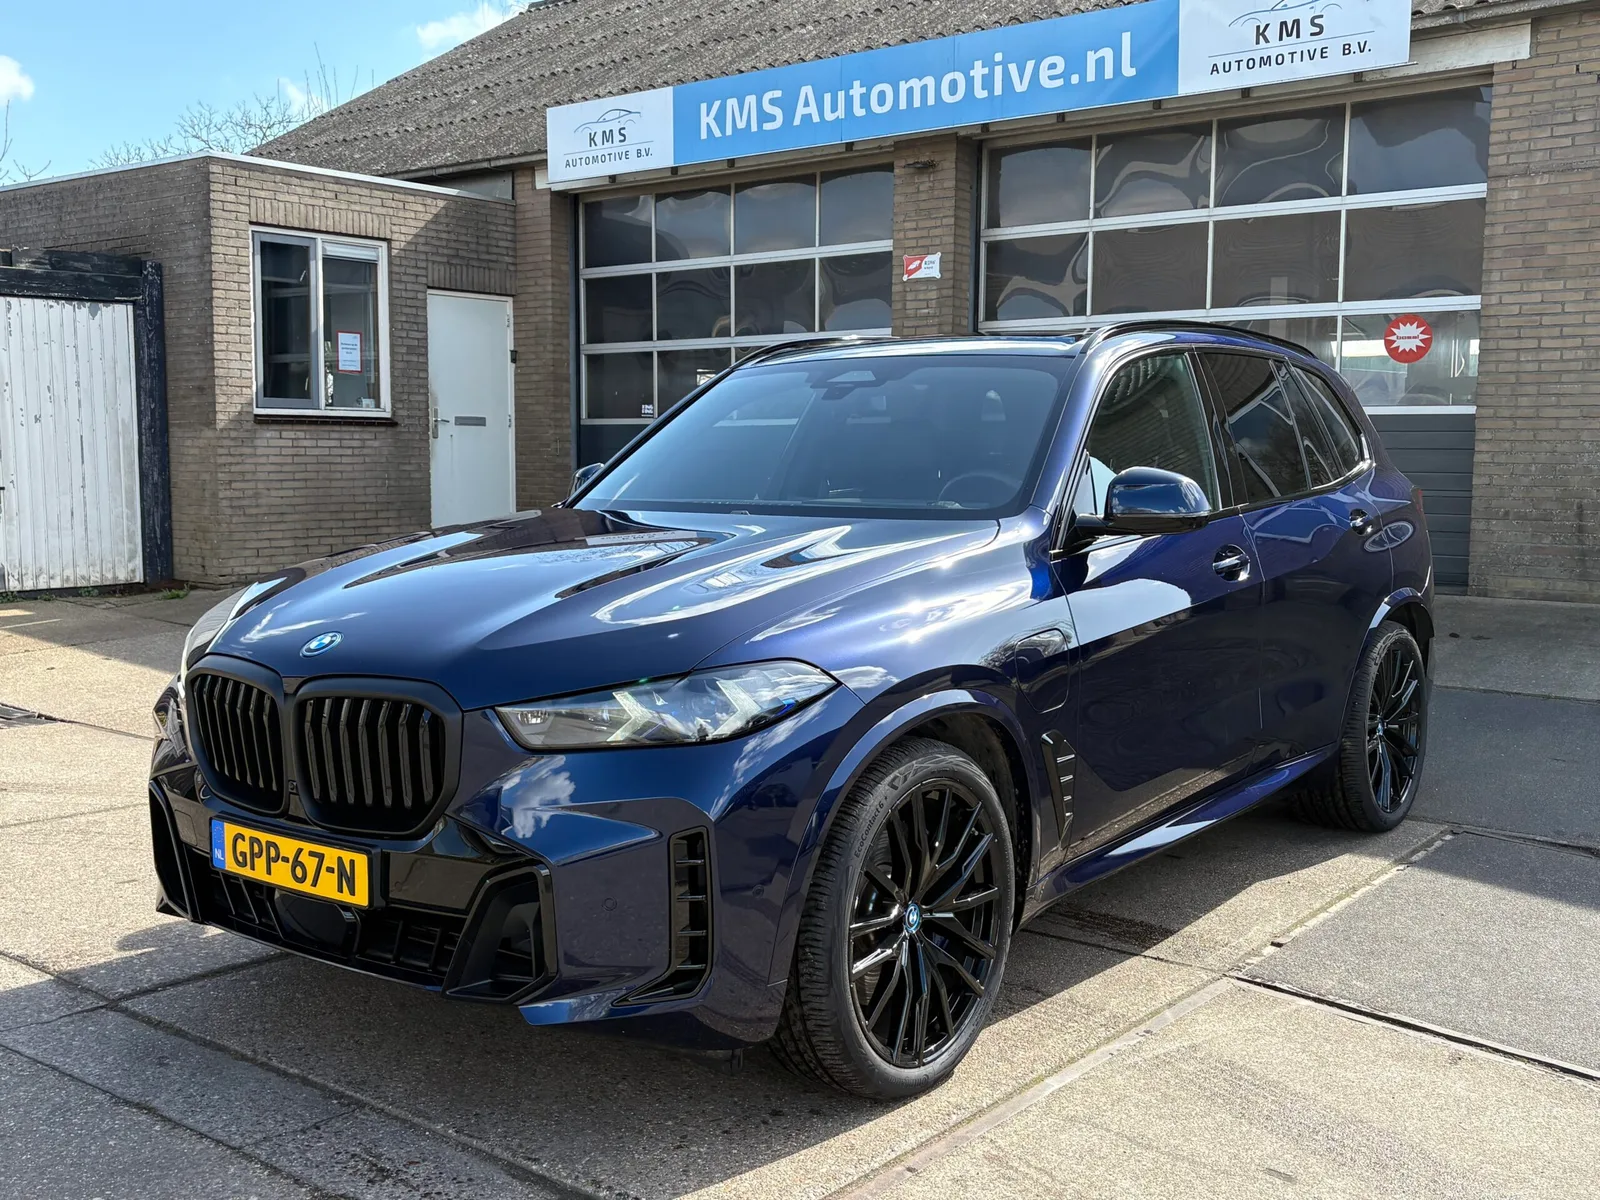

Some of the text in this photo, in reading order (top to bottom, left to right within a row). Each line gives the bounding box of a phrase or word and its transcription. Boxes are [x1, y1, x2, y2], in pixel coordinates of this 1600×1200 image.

[1255, 14, 1325, 46] KMS
[1210, 40, 1372, 76] AUTOMOTIVE B.V.
[700, 31, 1137, 140] KMS Automotive.nl
[588, 126, 627, 148] KMS
[564, 147, 653, 169] AUTOMOTIVE B.V.
[854, 807, 881, 859] EcoContact
[214, 848, 225, 861] NL
[232, 832, 356, 897] GPP-67-N
